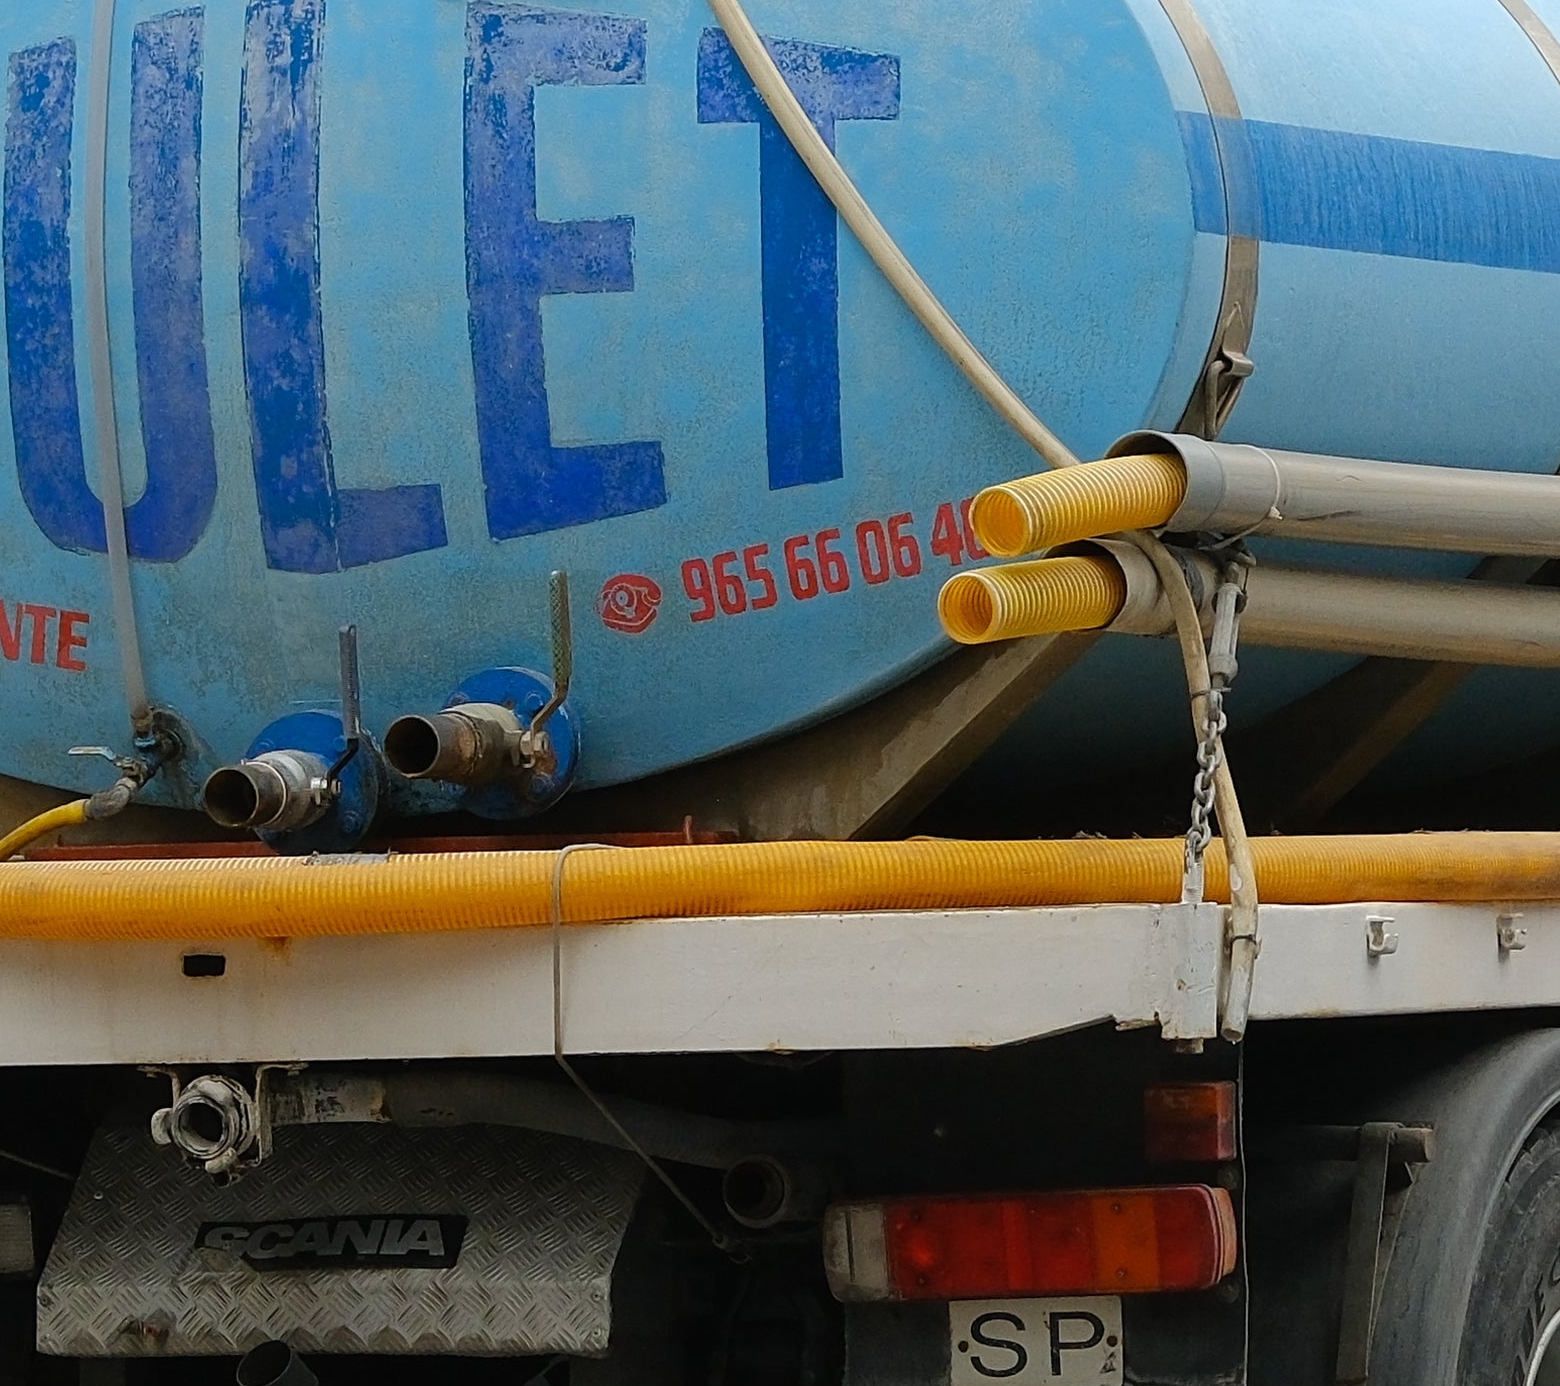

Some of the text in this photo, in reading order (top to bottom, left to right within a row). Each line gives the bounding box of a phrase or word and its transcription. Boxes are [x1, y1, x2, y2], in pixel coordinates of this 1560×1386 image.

[680, 542, 779, 622] 965
[783, 527, 851, 601] 66
[854, 512, 923, 586] 06
[204, 1219, 446, 1260] SCANIA
[970, 1311, 1105, 1379] SP
